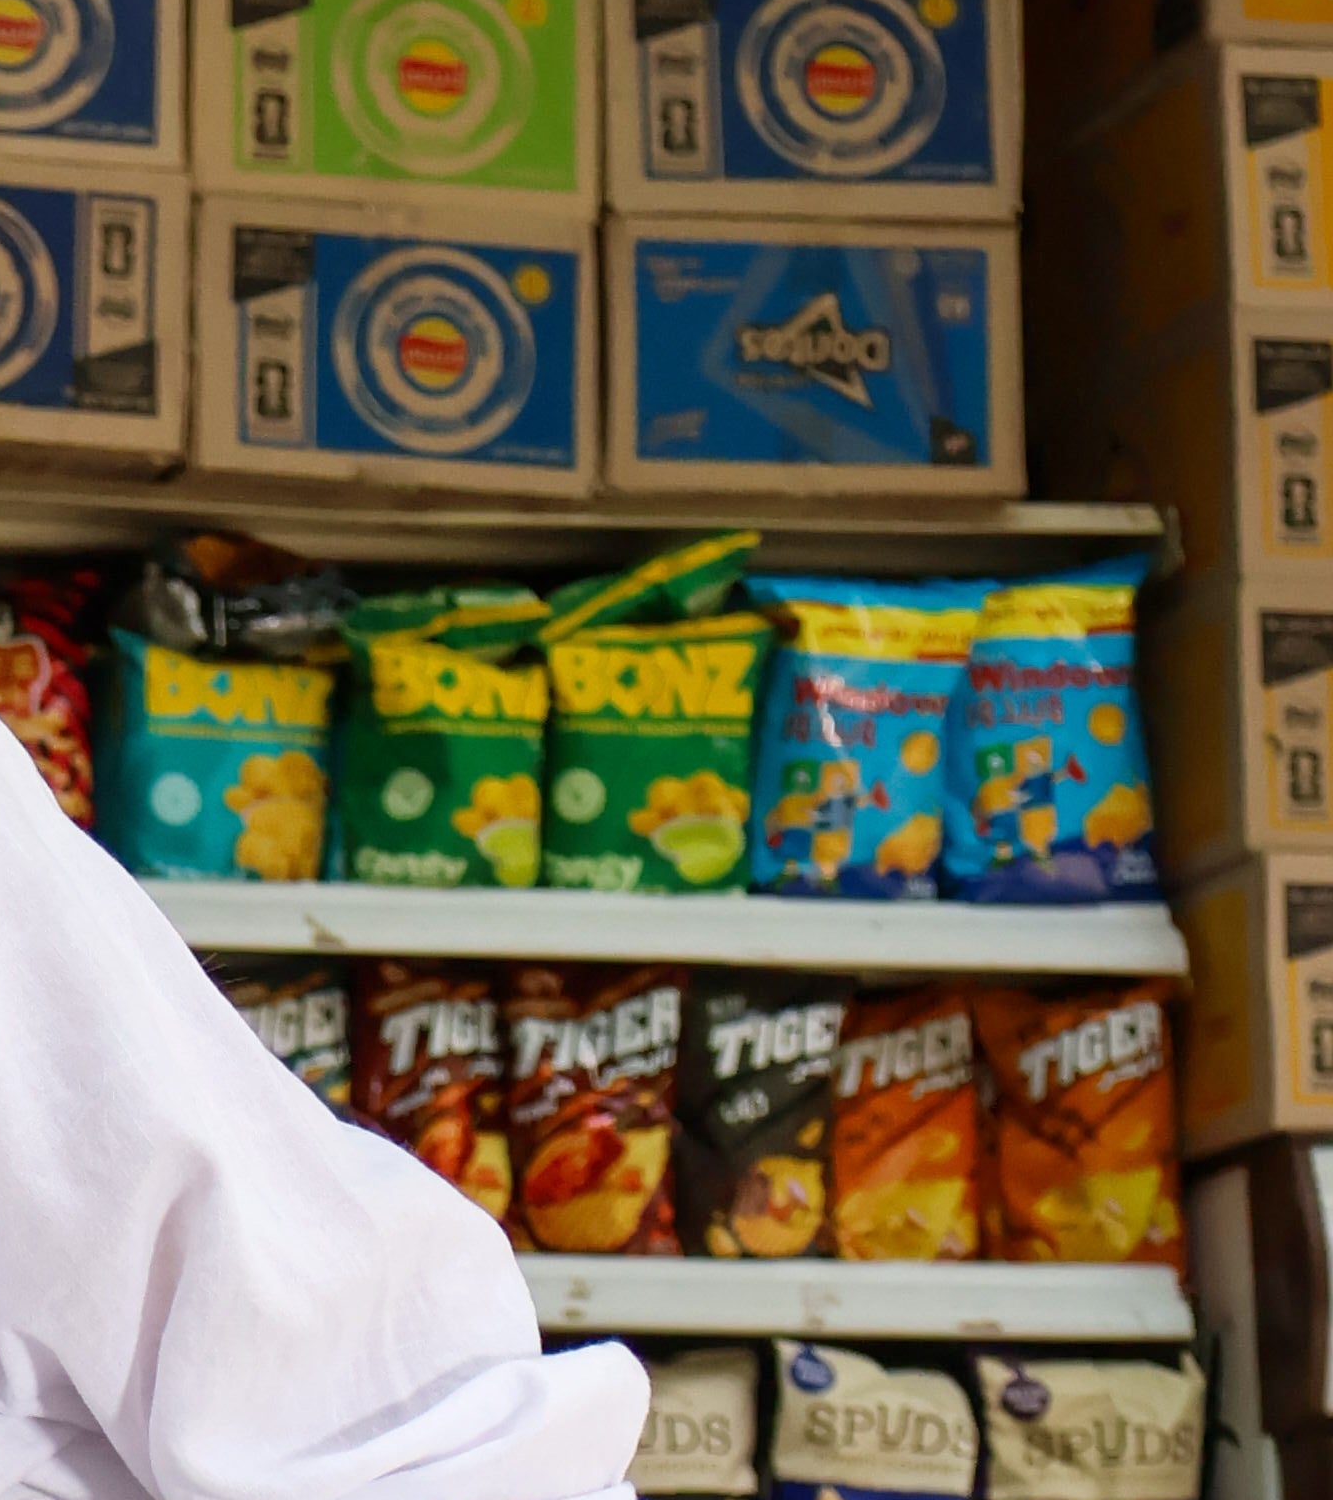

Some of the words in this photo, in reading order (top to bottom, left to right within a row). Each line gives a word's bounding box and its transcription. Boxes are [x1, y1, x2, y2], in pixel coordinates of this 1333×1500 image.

[550, 642, 757, 718] BONZ
[514, 987, 682, 1080] TIGER
[709, 1003, 846, 1080] TIGE
[835, 1011, 974, 1099] TIGER
[1019, 1000, 1164, 1101] TIGER
[637, 1410, 732, 1458] UDS
